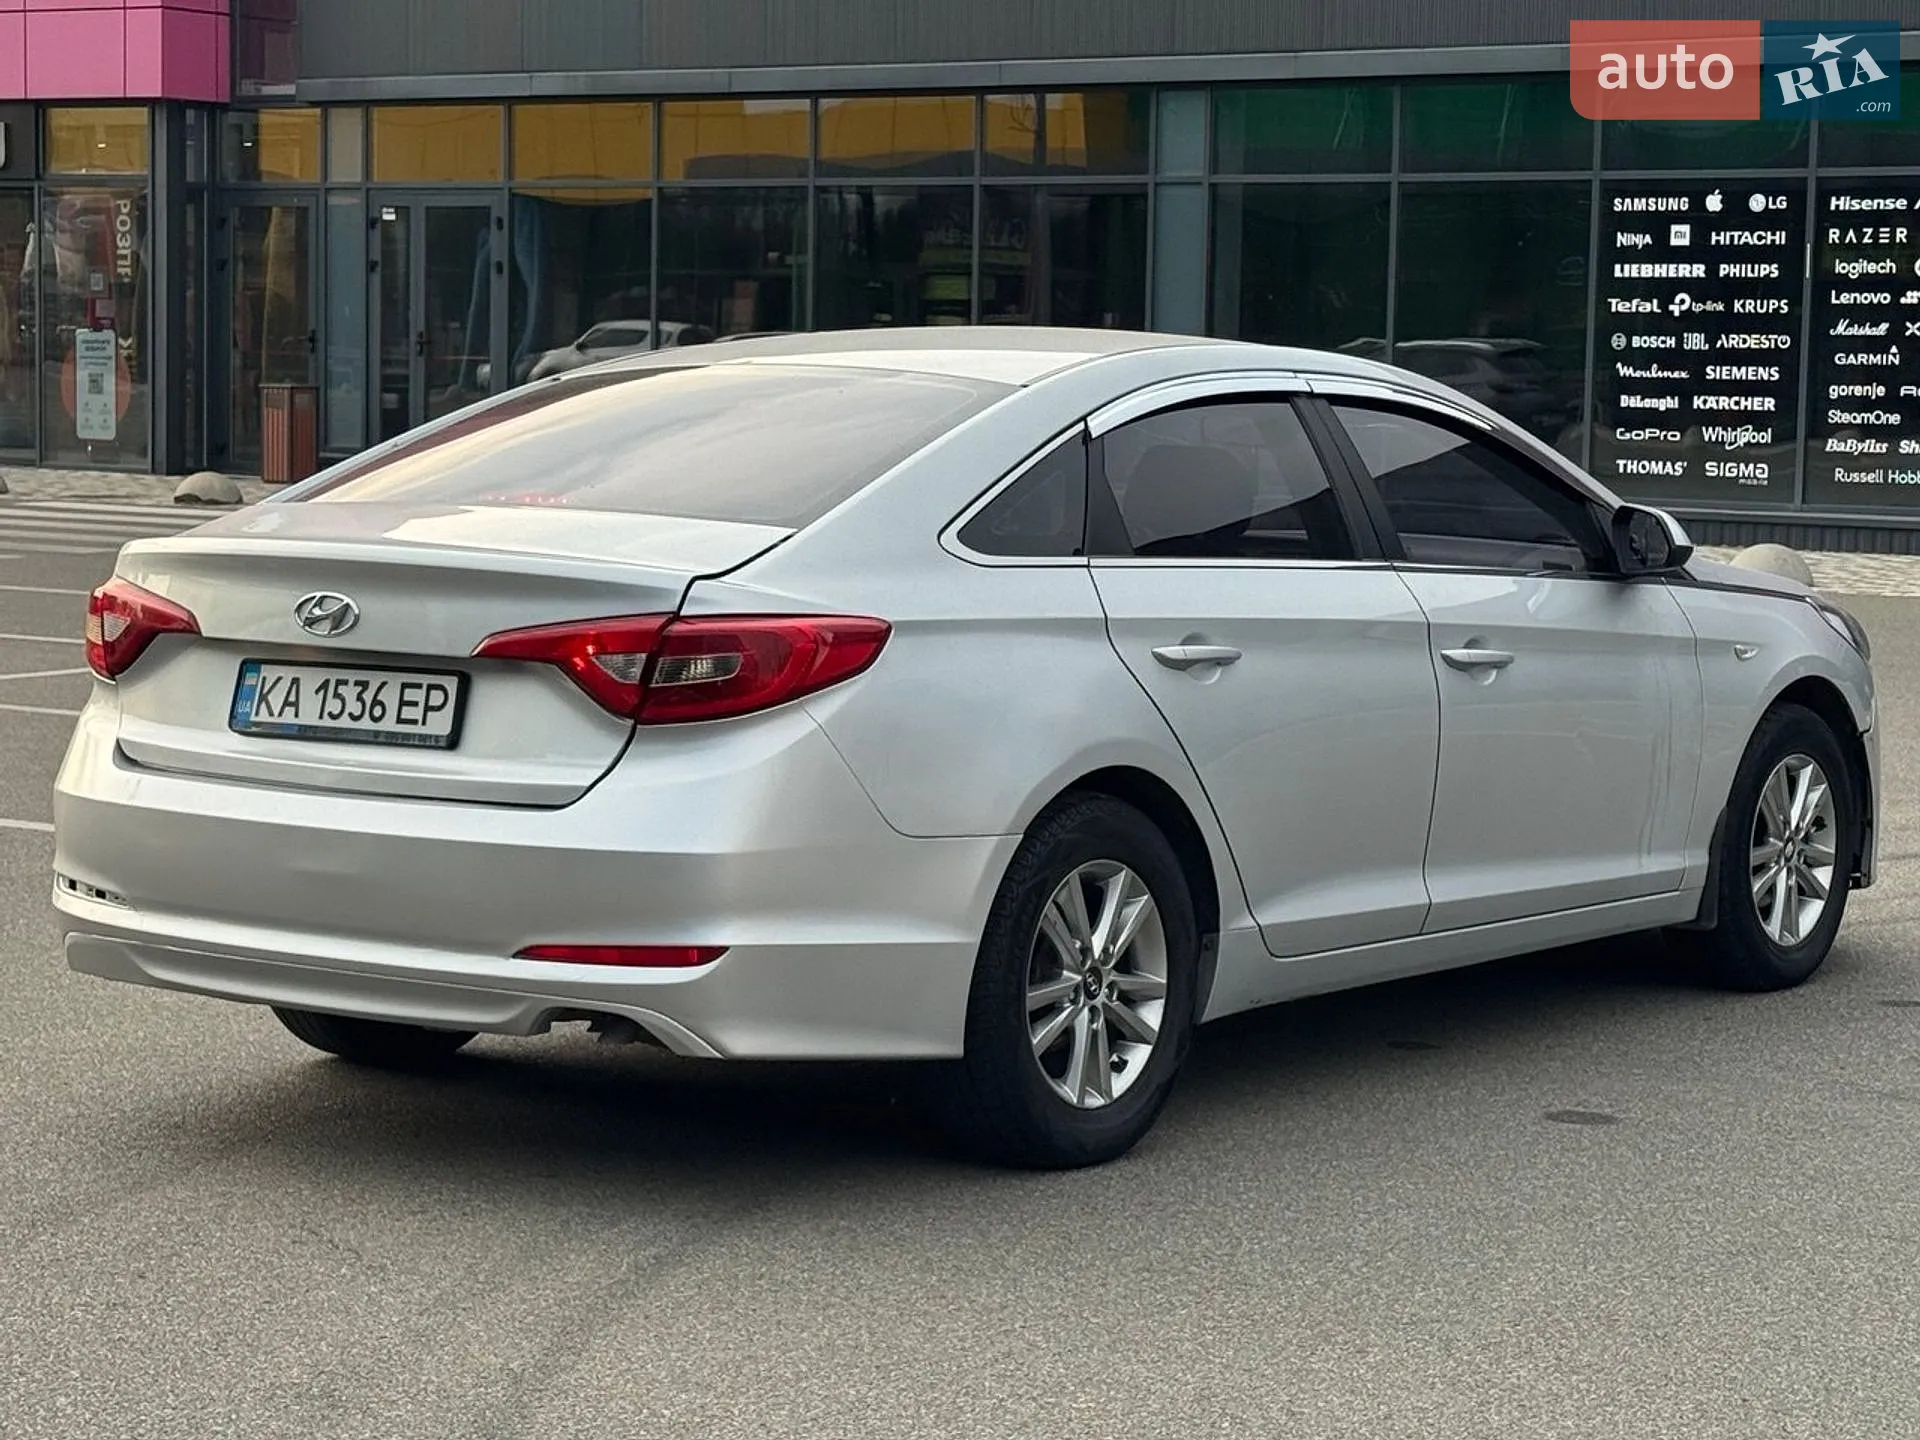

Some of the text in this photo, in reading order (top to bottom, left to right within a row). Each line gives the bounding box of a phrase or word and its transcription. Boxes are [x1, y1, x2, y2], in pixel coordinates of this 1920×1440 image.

[1614, 196, 1787, 211] SAMSUNG LG
[1830, 196, 1907, 210] Hisense
[1617, 232, 1652, 249] NINJA
[1711, 231, 1785, 245] HITACHI
[1829, 228, 1907, 243] RAZER
[1614, 264, 1778, 277] LIEBHERR PHILIPS
[1835, 259, 1896, 278] logitech
[1832, 290, 1891, 304] Lenovo
[1734, 299, 1788, 313] KRUPS
[1830, 319, 1889, 335] Marshall
[1632, 333, 1790, 350] BOSCH JBL ARDESTO
[1835, 353, 1899, 365] GARMIN
[1706, 366, 1779, 380] SIEMENS
[1829, 383, 1885, 399] gorenje
[1693, 396, 1775, 411] KÄRCHER
[1828, 410, 1901, 424] SteamOne
[1616, 425, 1771, 450] GoPro Whirlpool
[1825, 439, 1888, 455] BaByliss
[1835, 468, 1883, 483] Russell
[255, 675, 449, 726] KA 1536 EP
